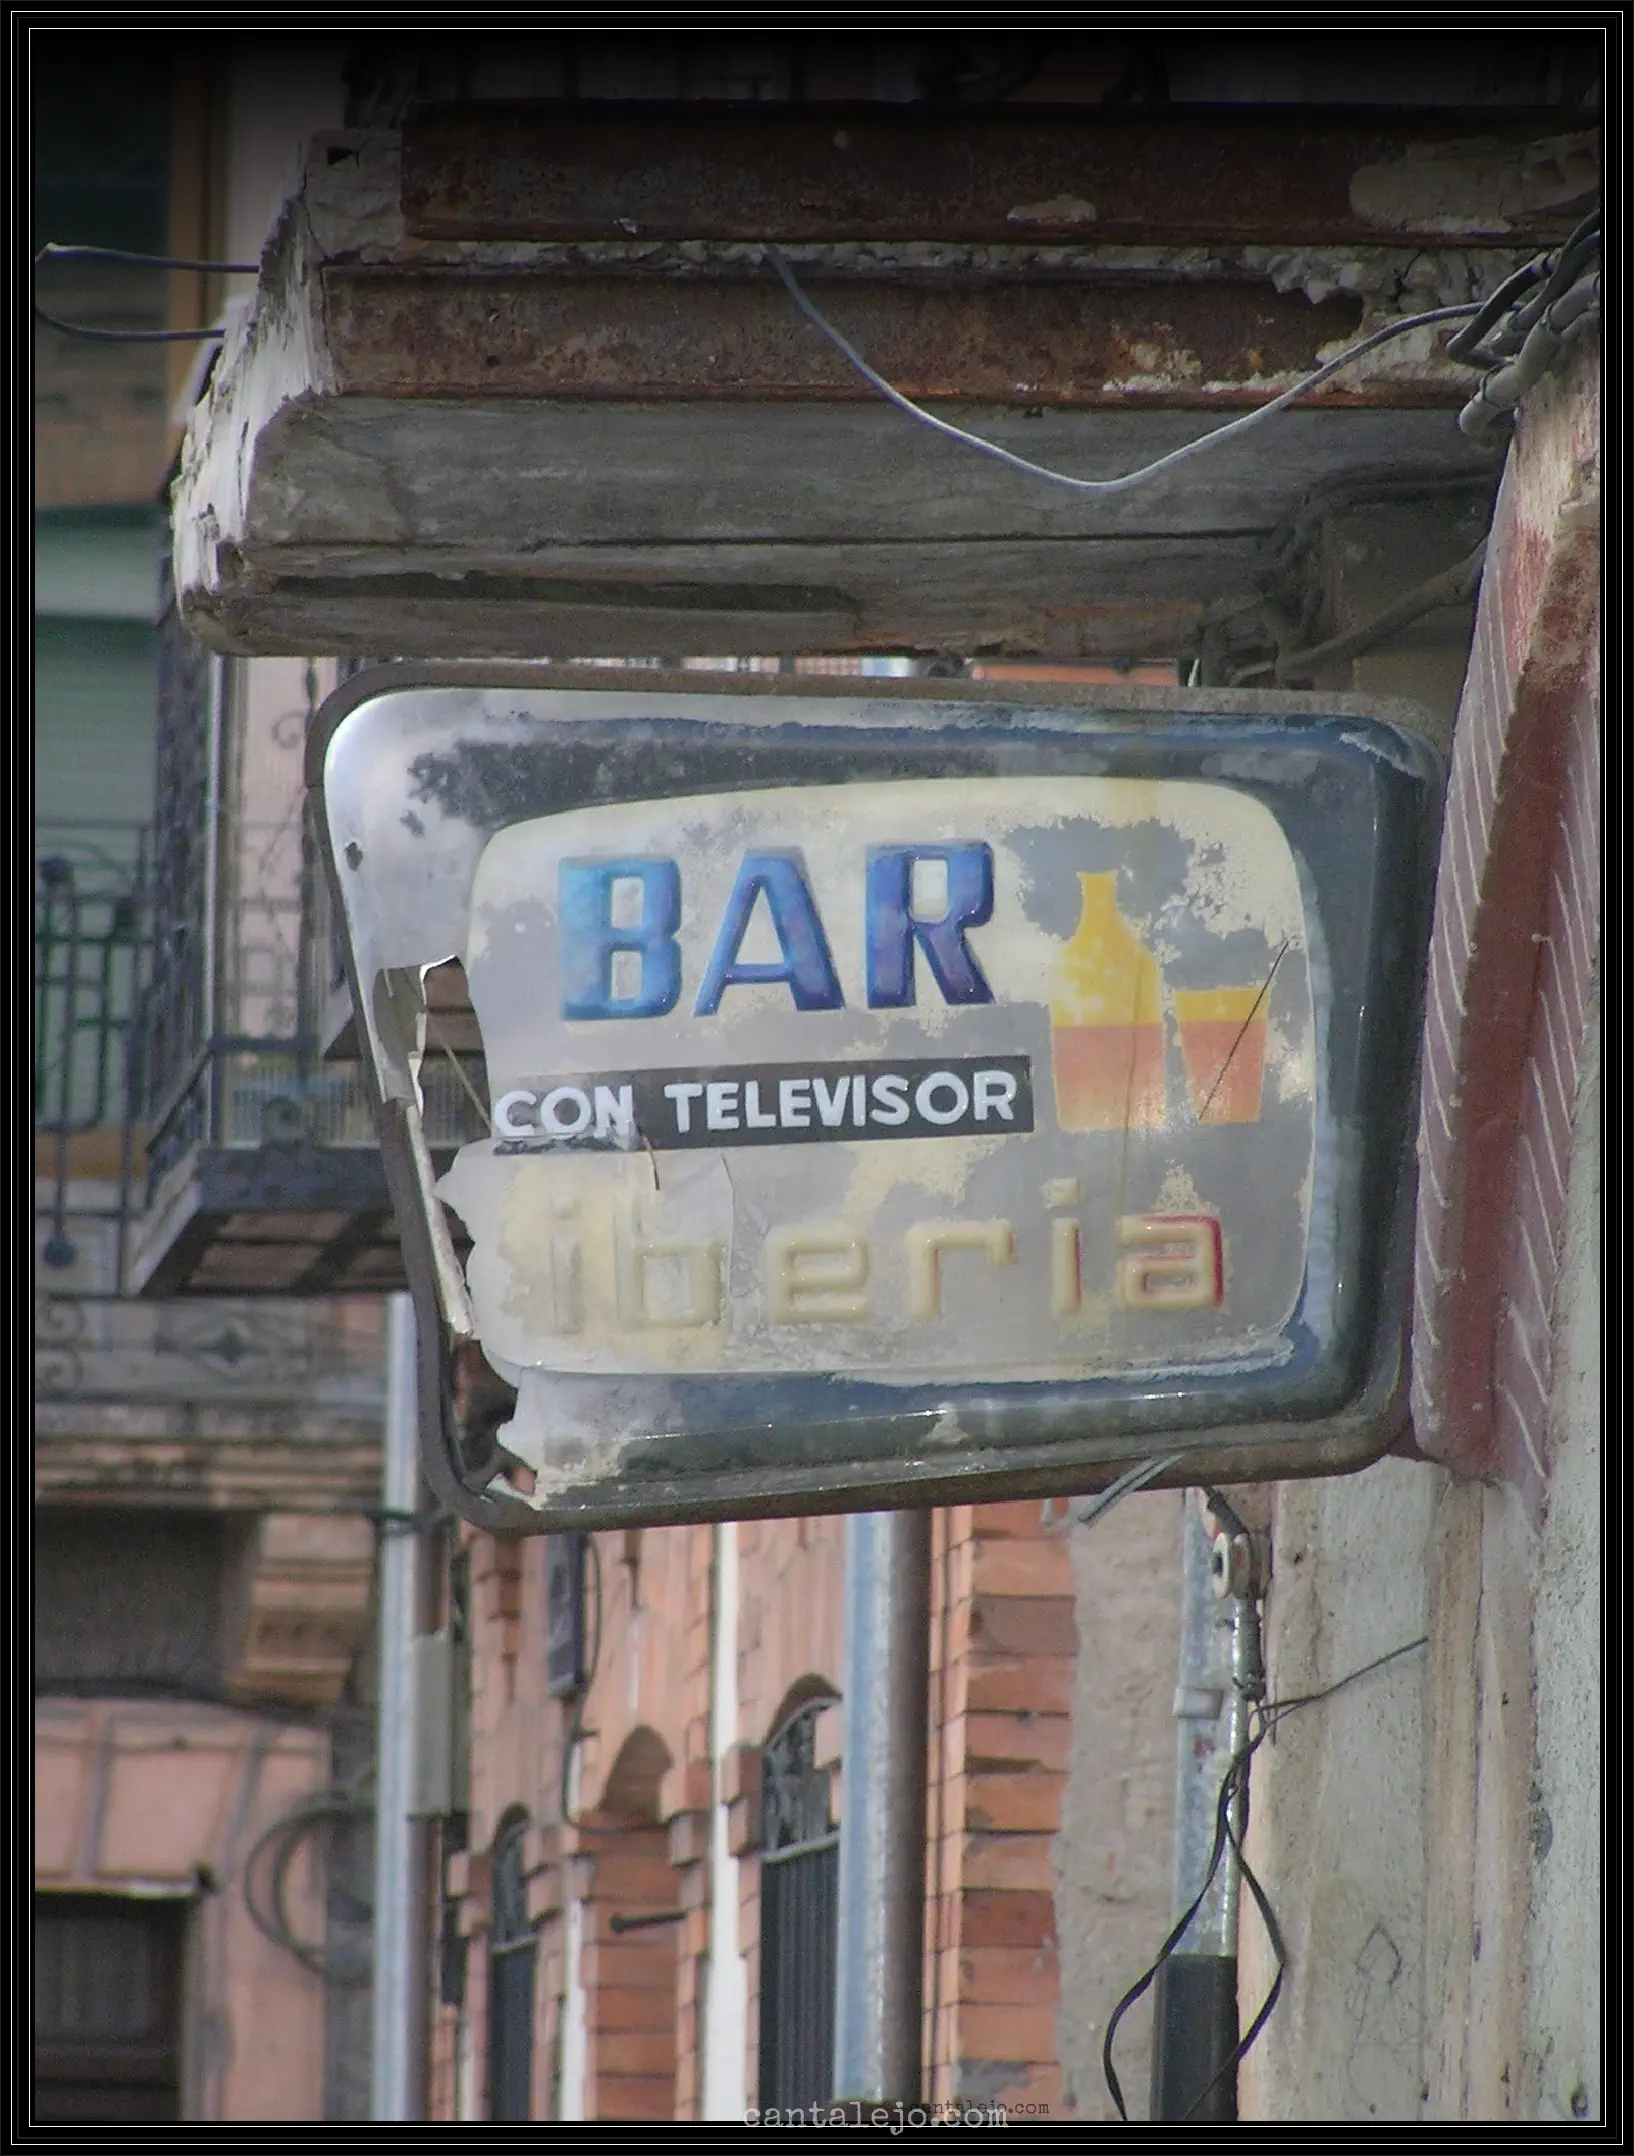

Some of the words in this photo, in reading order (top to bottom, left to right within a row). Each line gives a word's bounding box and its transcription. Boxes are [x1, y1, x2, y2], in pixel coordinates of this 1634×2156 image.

[558, 839, 995, 1022] BAR
[493, 1084, 636, 1141] CON
[665, 1069, 1017, 1134] TELEVISOR
[551, 1179, 1225, 1333] iberia
